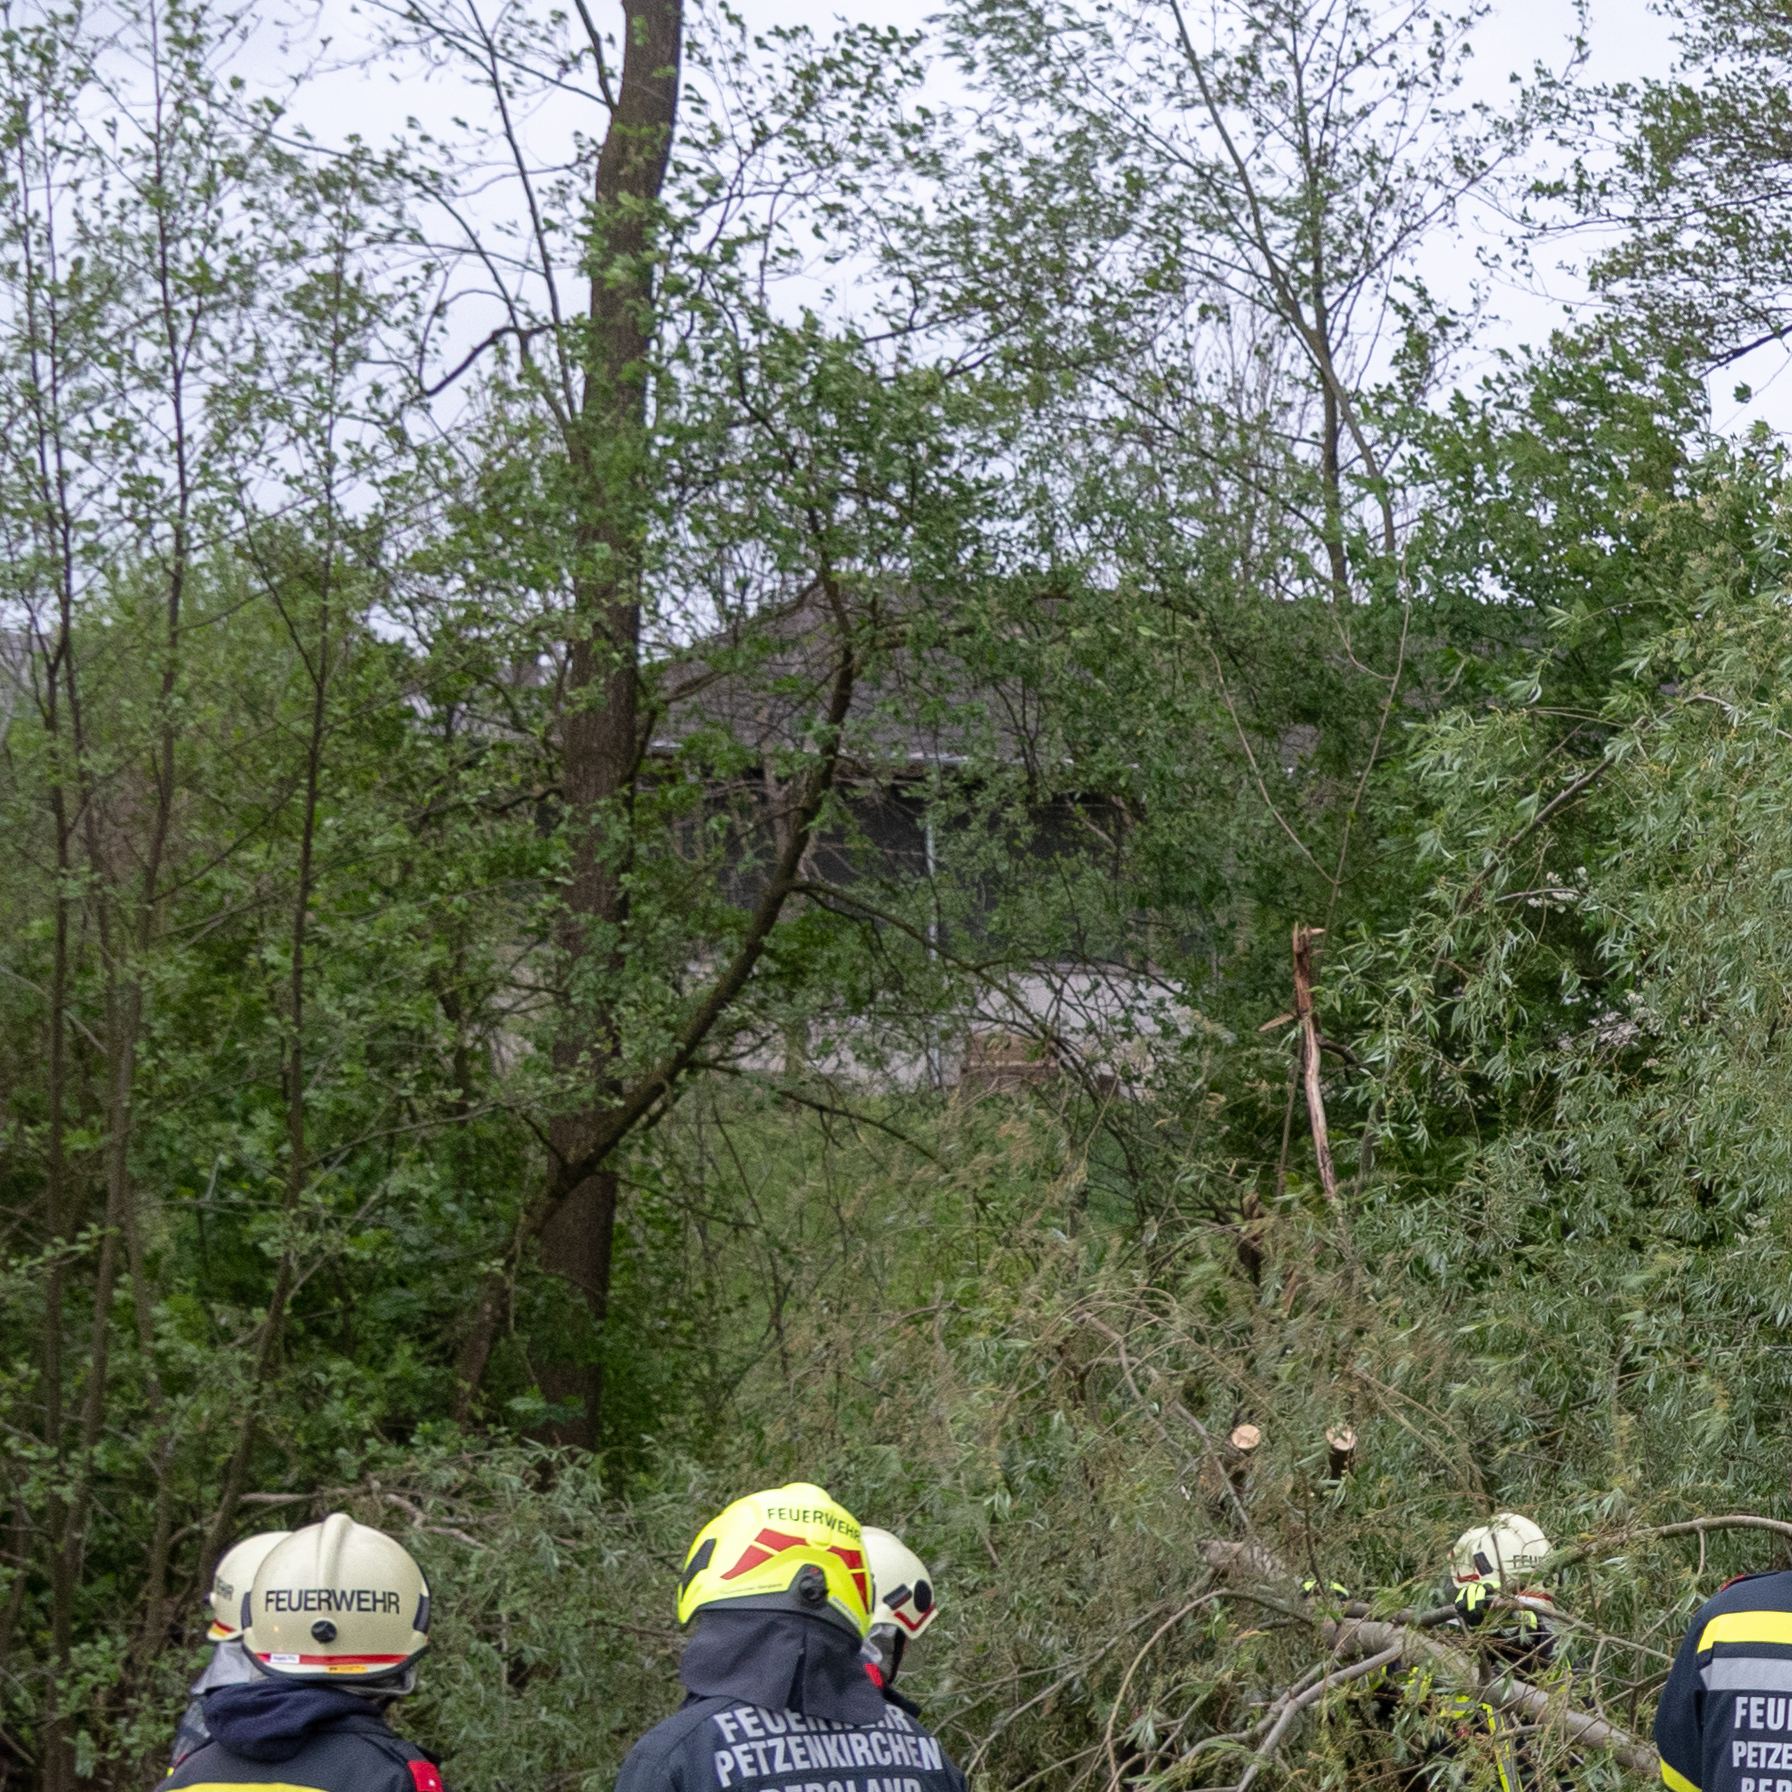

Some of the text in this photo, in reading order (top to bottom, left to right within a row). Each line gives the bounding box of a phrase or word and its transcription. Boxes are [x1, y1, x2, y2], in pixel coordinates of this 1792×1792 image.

[767, 1507, 861, 1542] FEUERWEHR
[265, 1588, 400, 1614] FEUERWEHR
[714, 1731, 944, 1788] PETZENKIRCHEN
